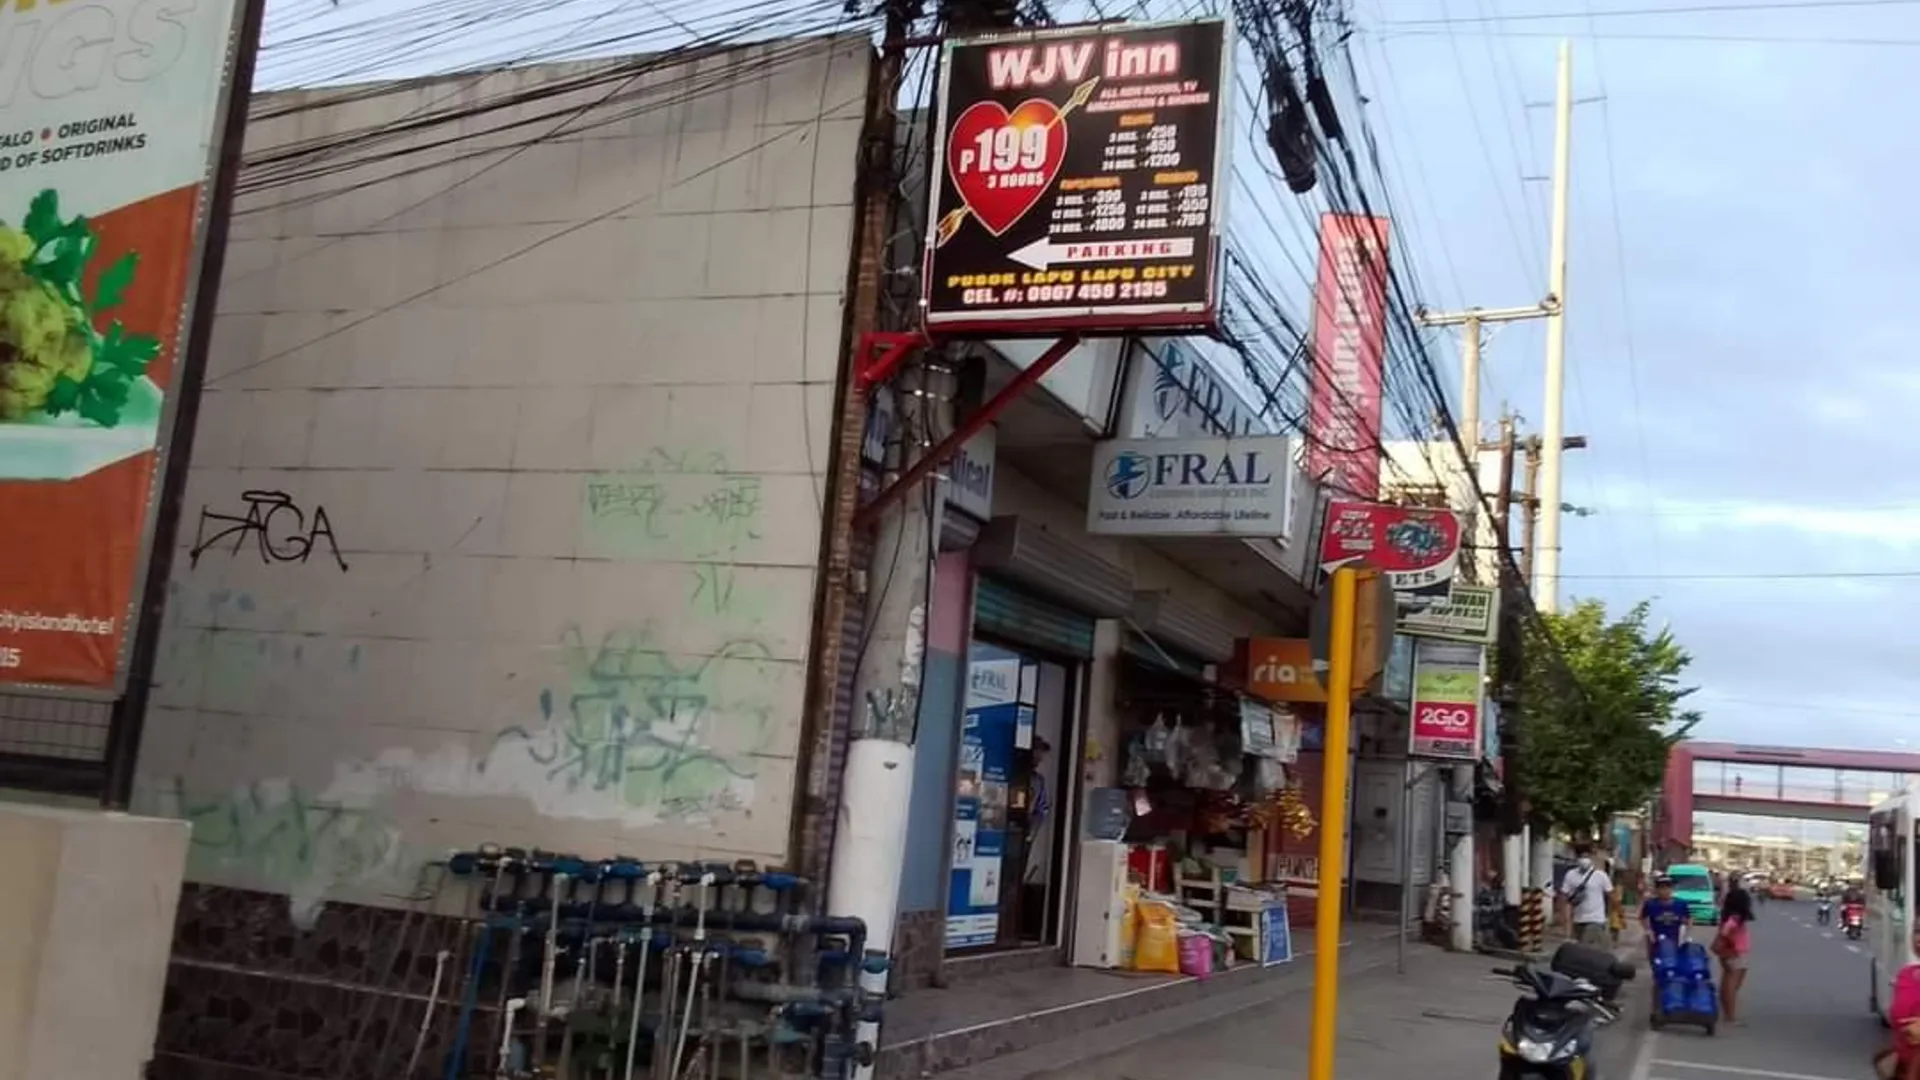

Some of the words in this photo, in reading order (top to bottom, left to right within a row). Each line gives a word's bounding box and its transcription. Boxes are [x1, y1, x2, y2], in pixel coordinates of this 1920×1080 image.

[989, 45, 1095, 88] WJV
[1106, 41, 1179, 77] inn
[57, 113, 138, 140] ORIGINAL
[16, 152, 40, 169] OF
[40, 133, 147, 165] SOFTDRINKS
[999, 170, 1044, 188] HOURS
[1067, 242, 1172, 259] PARKING
[1022, 269, 1074, 285] LAPU
[1081, 267, 1135, 282] LAPU
[1142, 264, 1195, 279] CITY
[963, 288, 999, 304] CEL.
[1153, 451, 1272, 486] FRAL
[1395, 569, 1437, 586] ETS
[1254, 653, 1296, 684] ria
[1421, 707, 1469, 726] 2GO
